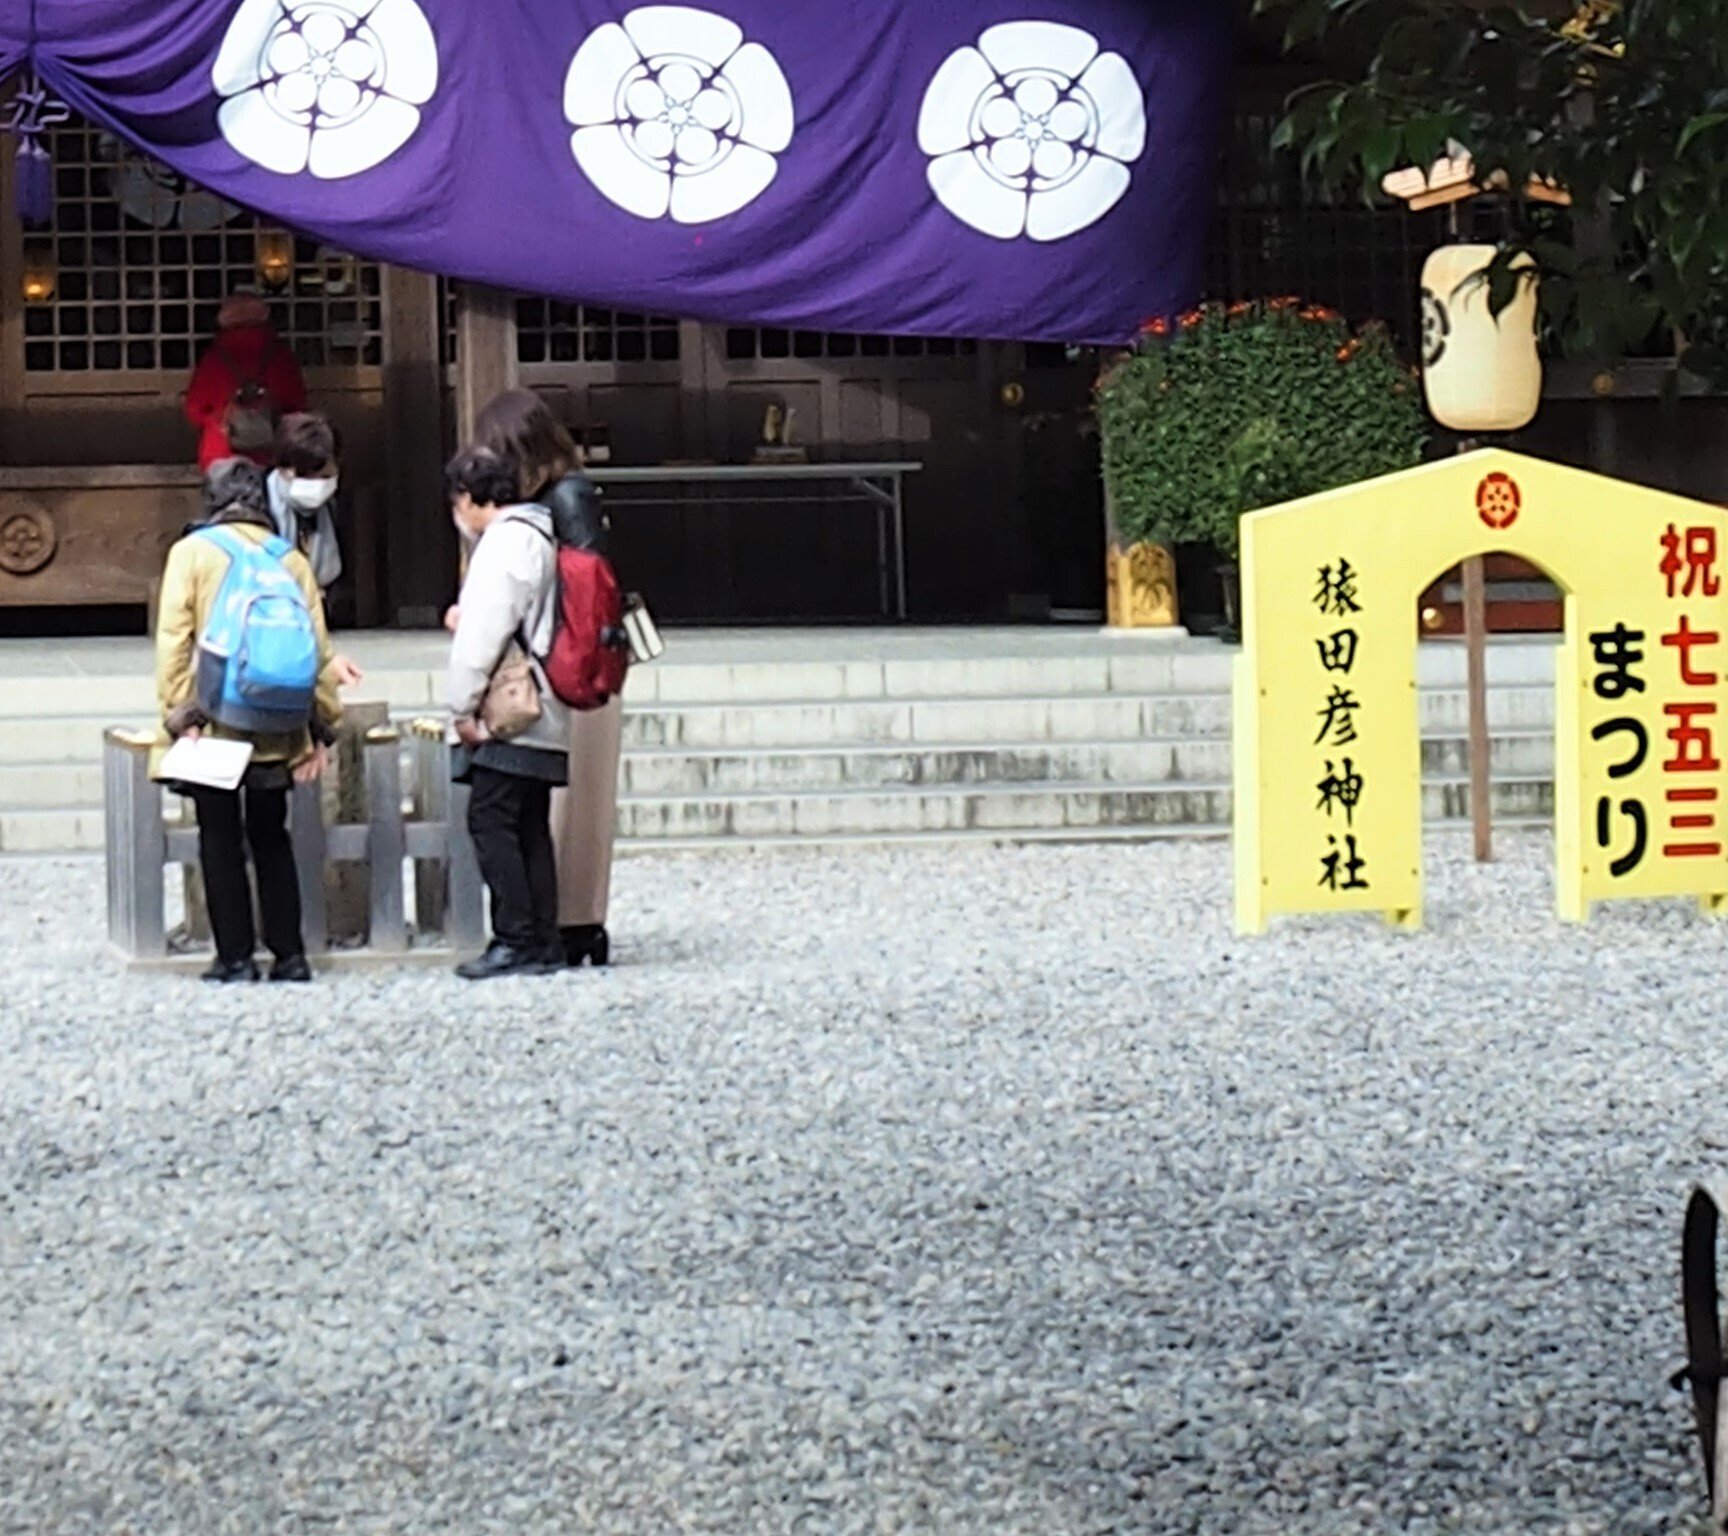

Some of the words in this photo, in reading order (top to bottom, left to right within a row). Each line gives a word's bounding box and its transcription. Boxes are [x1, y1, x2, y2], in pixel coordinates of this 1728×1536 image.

[1312, 557, 1370, 892] 猿田彦神社
[1588, 622, 1649, 878] まつり
[1659, 523, 1720, 859] 祝七五三
